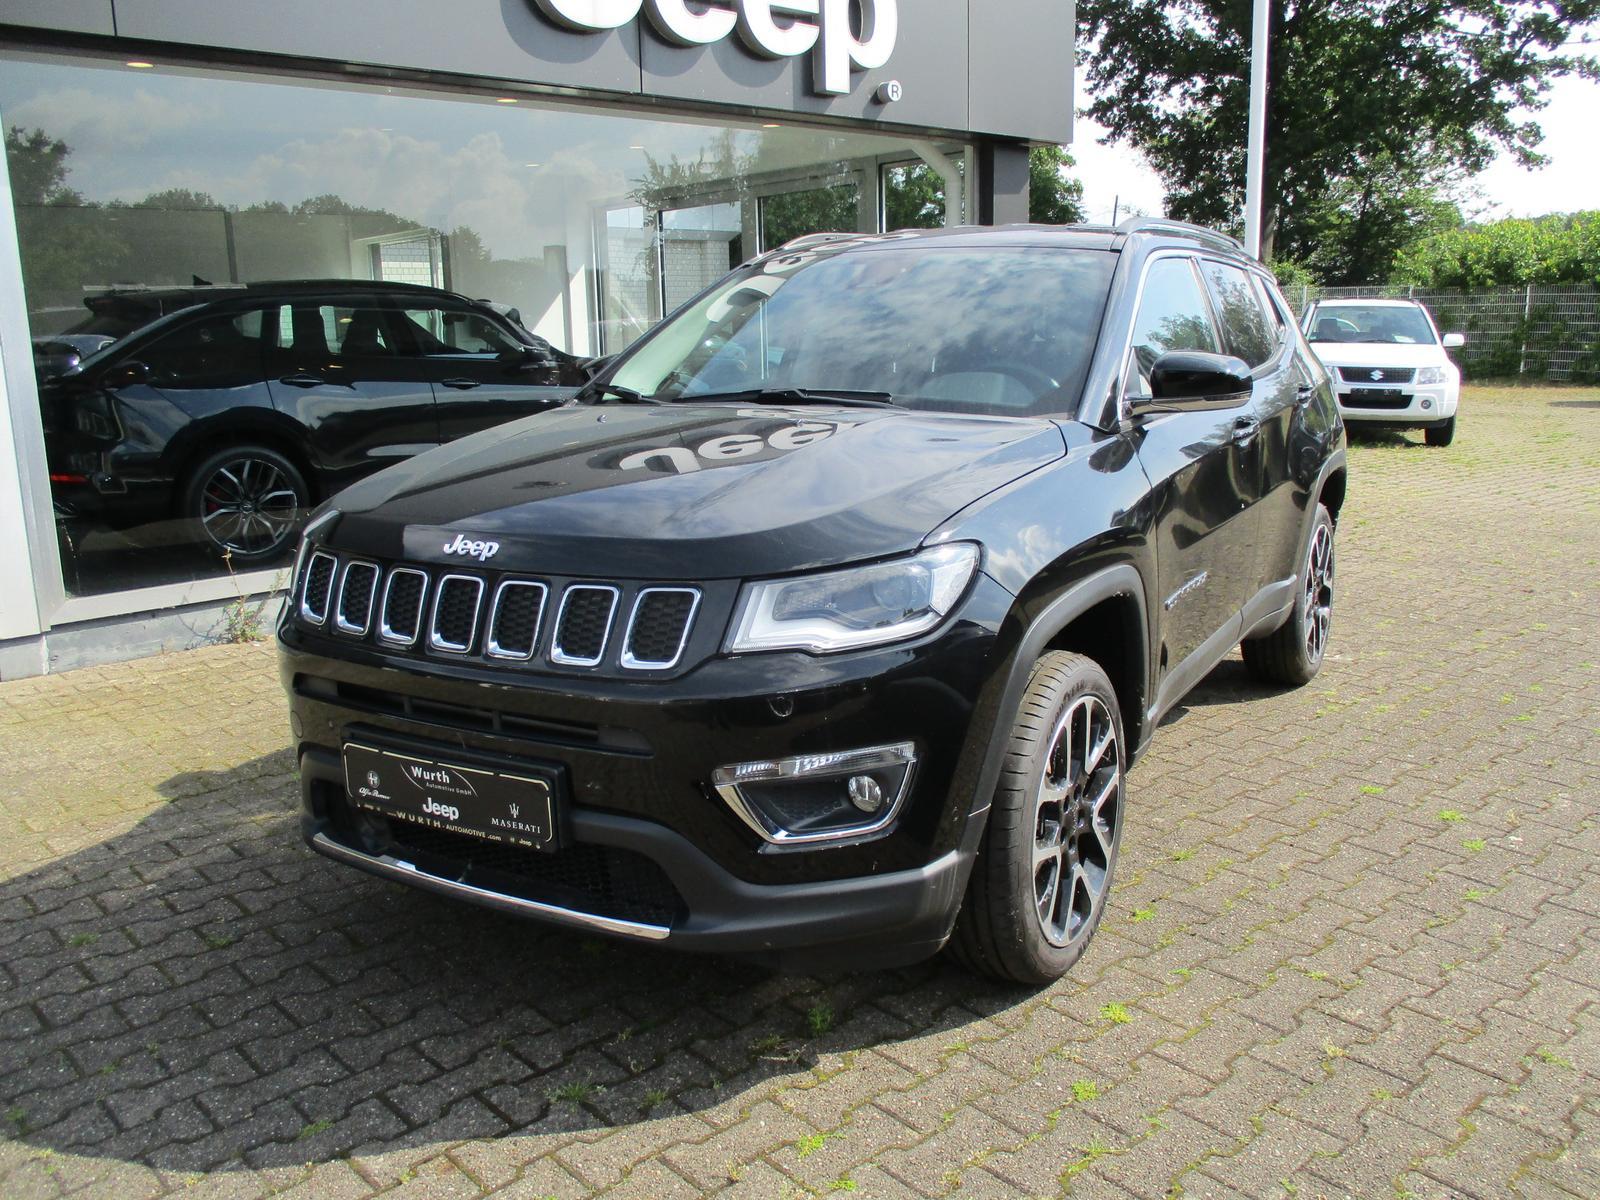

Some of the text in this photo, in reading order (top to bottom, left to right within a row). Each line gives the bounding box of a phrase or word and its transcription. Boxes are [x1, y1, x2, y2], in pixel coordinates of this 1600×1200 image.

[443, 534, 500, 562] Jeep
[411, 765, 450, 784] Wurth
[422, 796, 460, 821] Jeep
[491, 817, 541, 834] MASERATI
